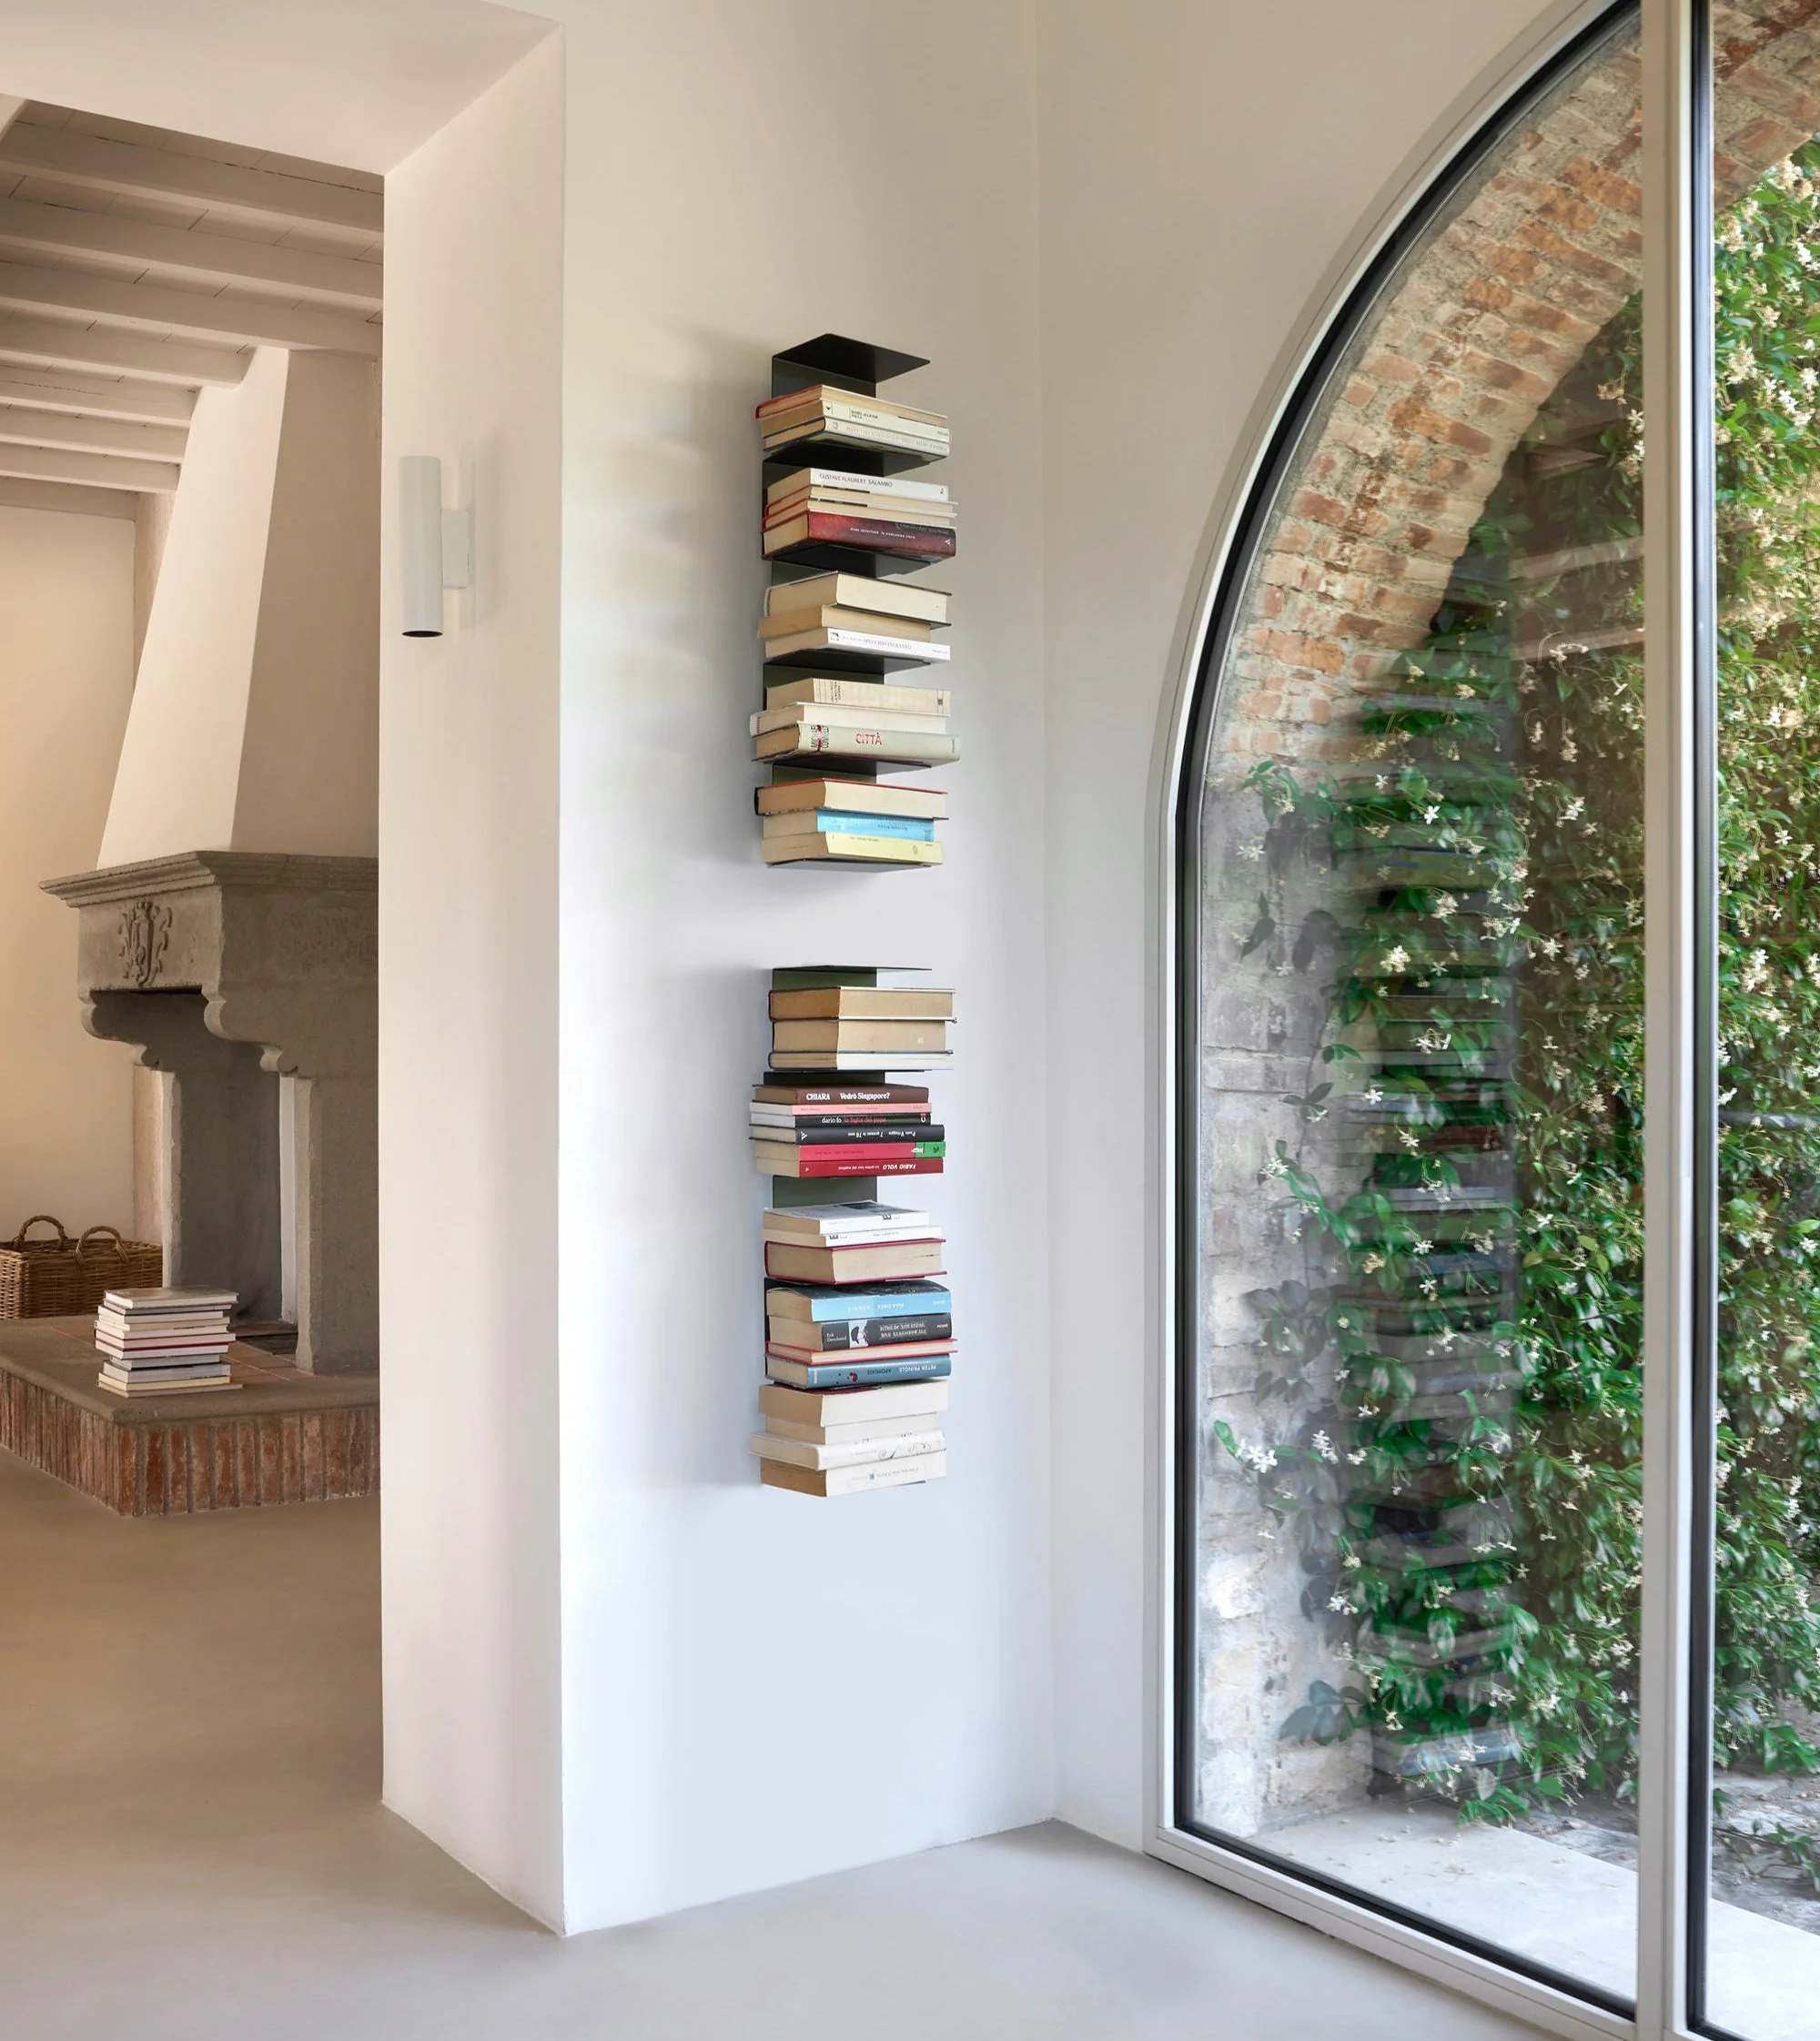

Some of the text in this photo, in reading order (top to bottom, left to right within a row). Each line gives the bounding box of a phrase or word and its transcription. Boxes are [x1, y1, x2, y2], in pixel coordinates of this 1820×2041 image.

[819, 473, 841, 481] GUSTAVE
[855, 732, 882, 745] CITTÀ
[858, 1092, 890, 1101] Singapore?
